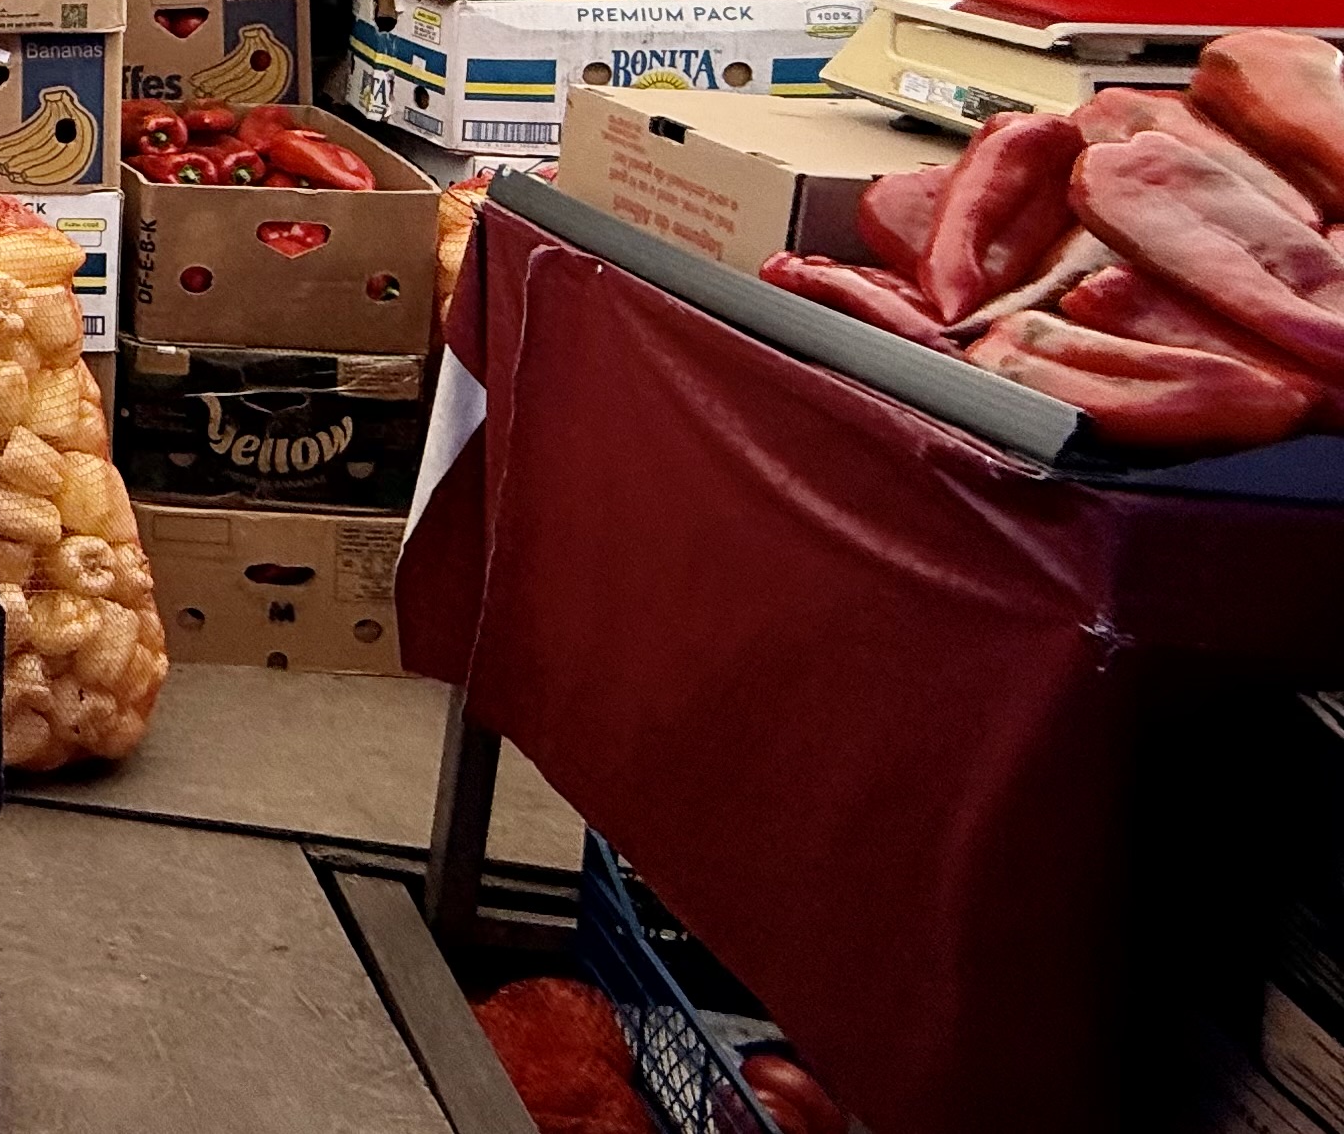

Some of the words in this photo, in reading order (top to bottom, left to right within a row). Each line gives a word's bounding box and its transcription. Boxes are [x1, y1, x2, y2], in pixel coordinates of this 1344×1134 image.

[576, 5, 685, 23] PREMIUM
[693, 5, 754, 22] PACK
[817, 11, 852, 21] 100%
[26, 42, 104, 59] Bananas
[611, 49, 719, 89] BONITA
